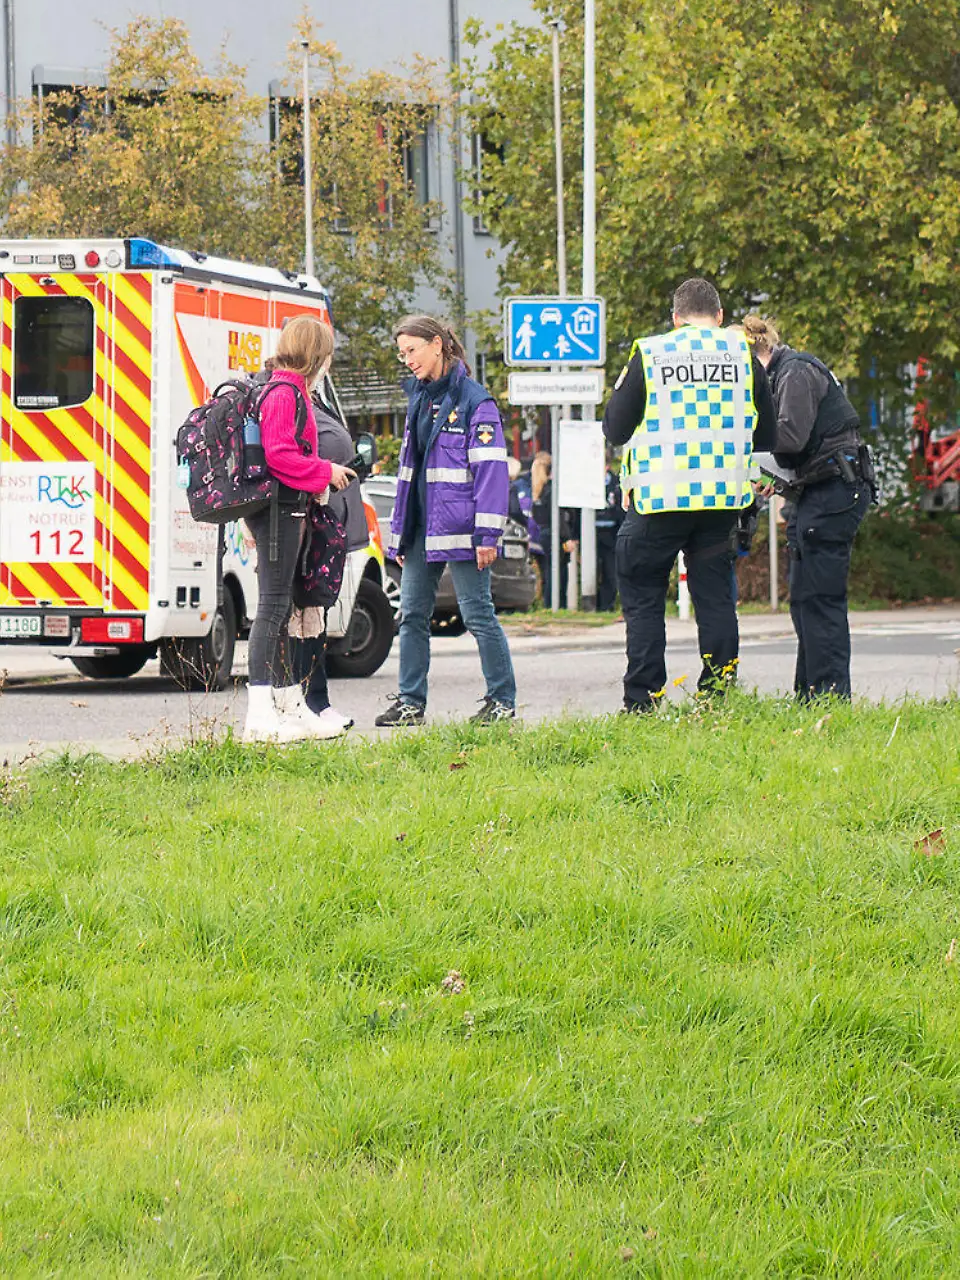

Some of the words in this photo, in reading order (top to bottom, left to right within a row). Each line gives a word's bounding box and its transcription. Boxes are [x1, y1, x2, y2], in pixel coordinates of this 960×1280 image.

[237, 332, 262, 373] ASB
[661, 363, 739, 386] POLIZEI
[28, 513, 88, 526] NOTRUF
[29, 529, 85, 556] 112
